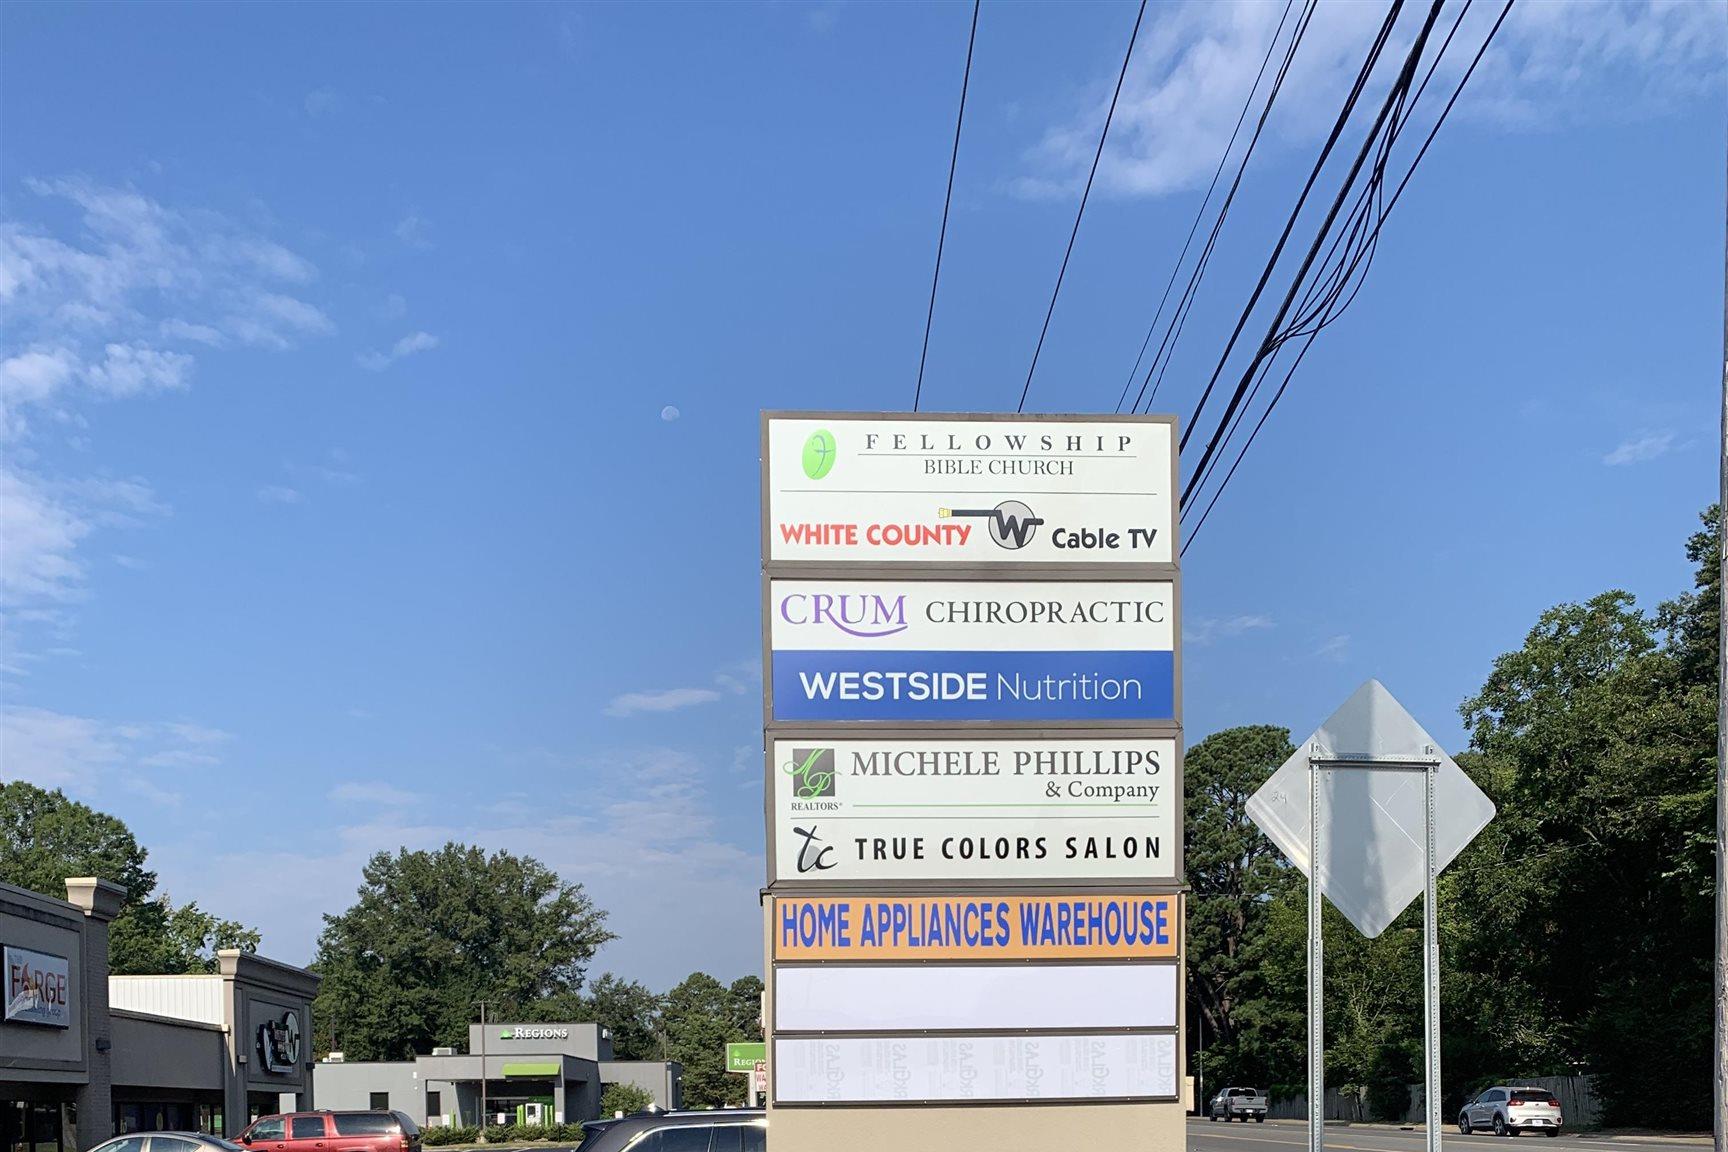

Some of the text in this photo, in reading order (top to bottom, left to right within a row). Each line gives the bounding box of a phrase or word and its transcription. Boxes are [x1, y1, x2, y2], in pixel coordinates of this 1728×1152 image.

[865, 433, 1133, 452] FELLOWSHIP
[924, 459, 1074, 476] BIBLE CHURCH
[780, 523, 858, 546] WHITE
[866, 523, 972, 546] COUNTY
[1052, 528, 1120, 549] Cable
[1128, 528, 1158, 549] TV
[780, 594, 1165, 638] CRUM CHIROPRACTIC
[799, 672, 1142, 701] WESTSIDE Nutrition
[851, 750, 1161, 777] MICHELE PHILLIPS
[1045, 780, 1161, 803] & Company
[855, 837, 1161, 861] TRUE COLORS SALON
[782, 901, 1170, 948] HOME APPLIANCES WAREHOUSE
